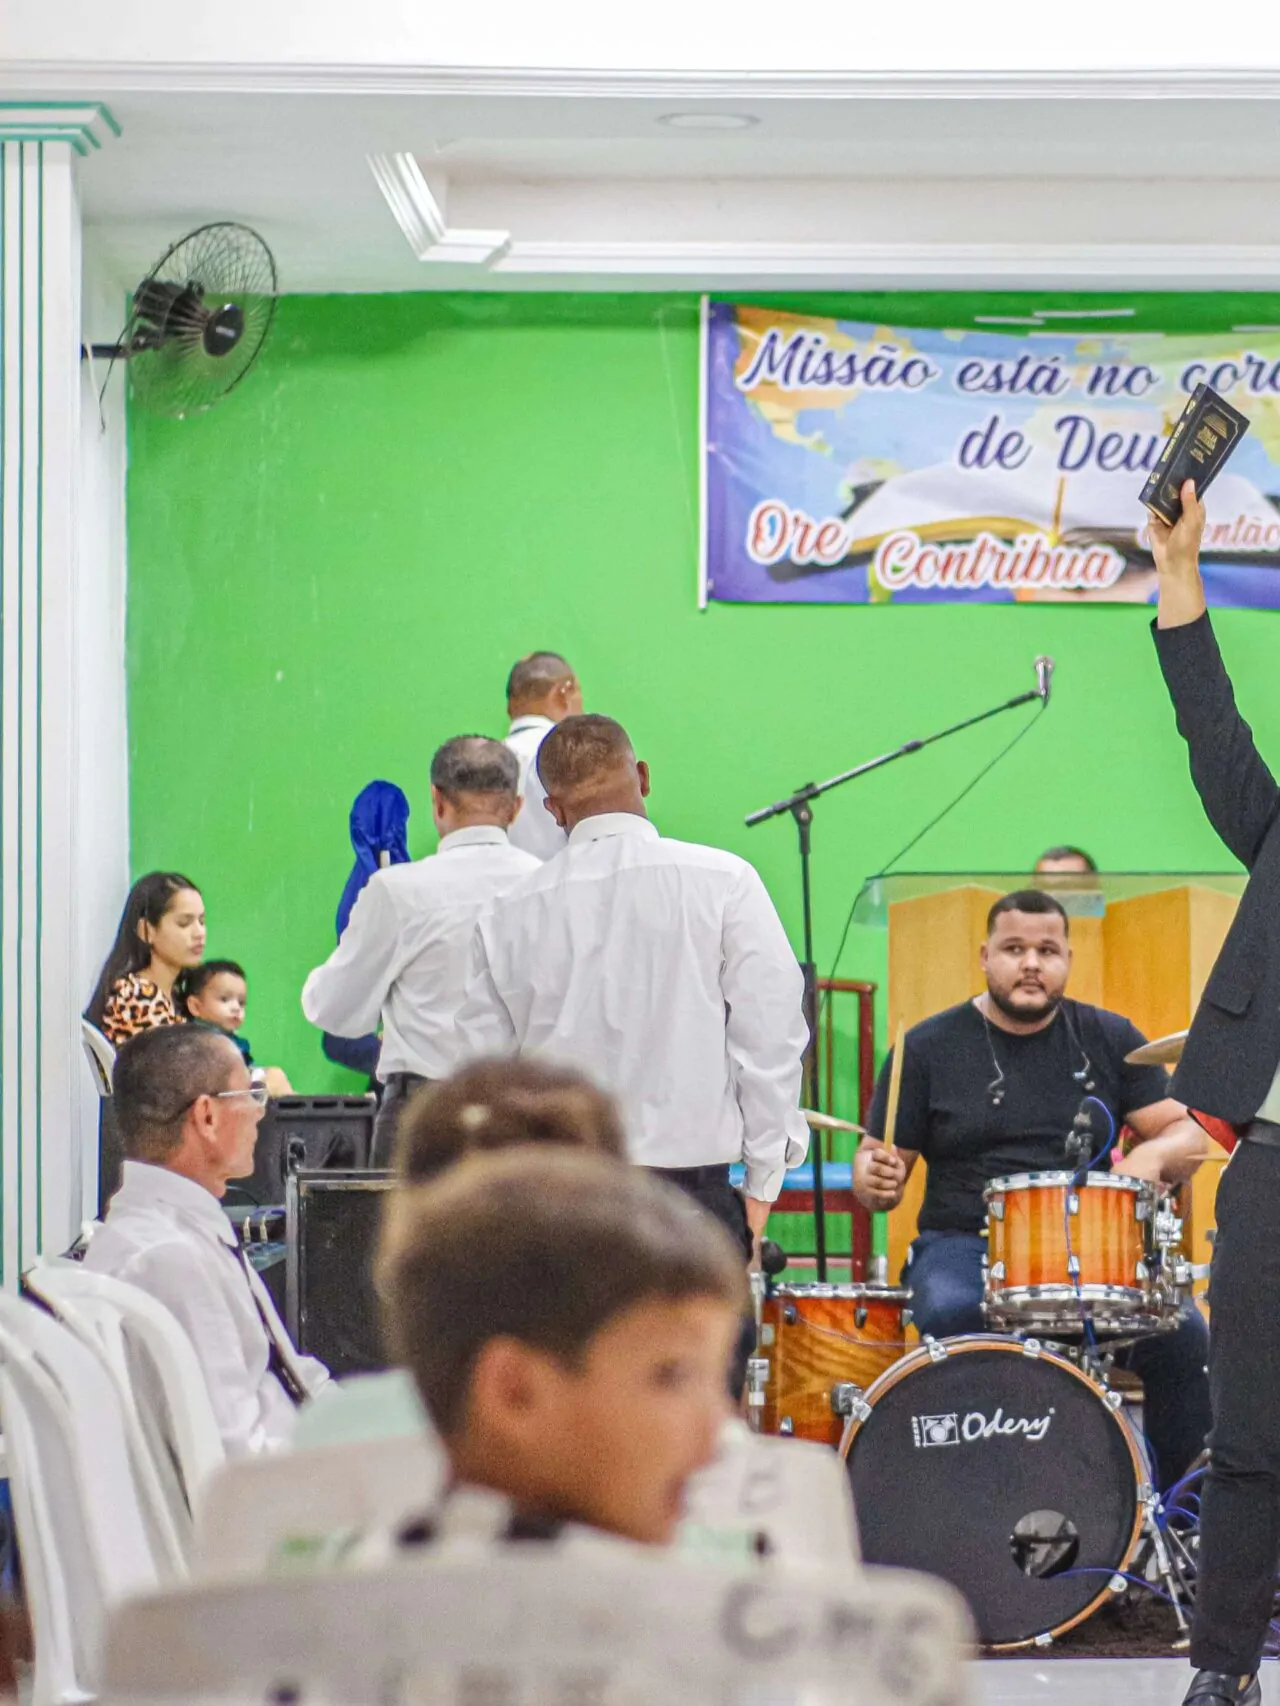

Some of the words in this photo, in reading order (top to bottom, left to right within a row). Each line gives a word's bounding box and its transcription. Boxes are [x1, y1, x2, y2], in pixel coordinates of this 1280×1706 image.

[742, 332, 938, 388] Missão
[957, 355, 1069, 396] está
[1087, 364, 1160, 396] no
[958, 415, 1033, 470] de
[1054, 415, 1160, 472] Deu
[752, 503, 849, 560] Ore
[880, 536, 1121, 585] Contribua
[962, 1407, 1051, 1440] Odery
